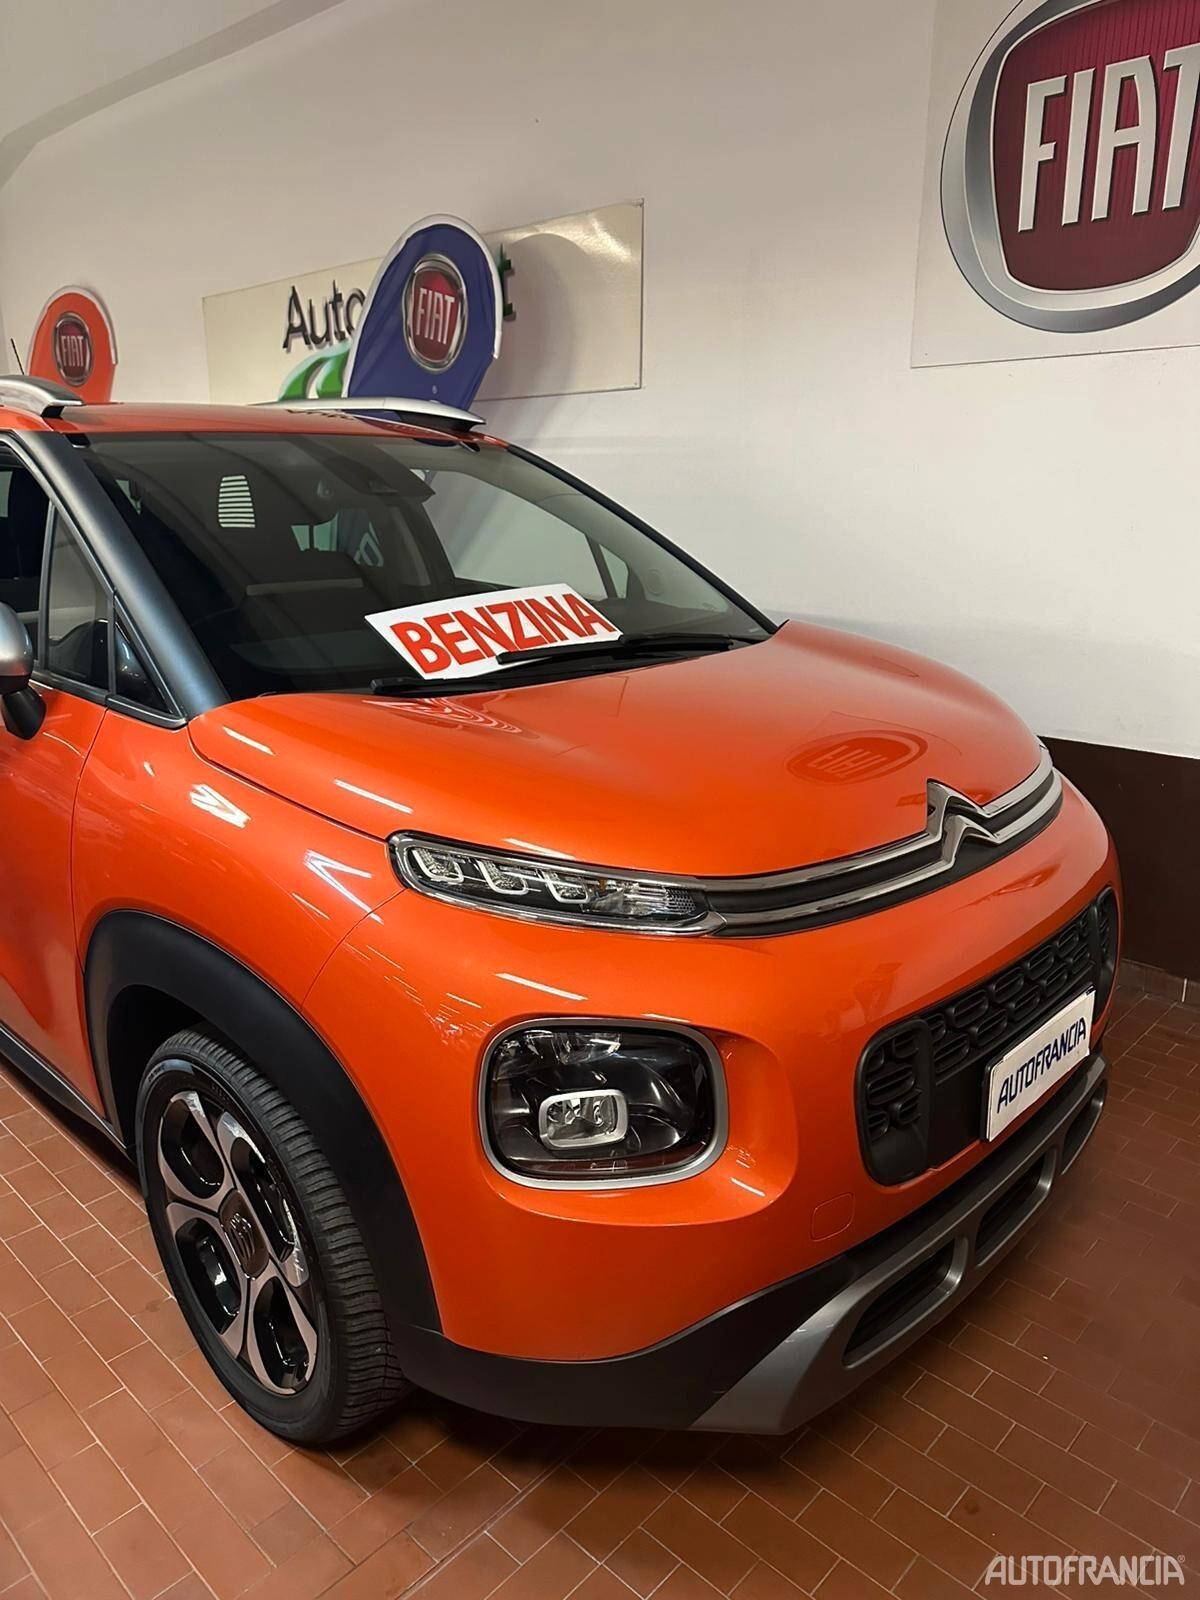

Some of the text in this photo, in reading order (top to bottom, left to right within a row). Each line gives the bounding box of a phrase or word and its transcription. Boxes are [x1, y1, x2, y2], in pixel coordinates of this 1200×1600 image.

[1018, 43, 1200, 233] FIAT
[61, 335, 84, 367] FIAT
[416, 287, 455, 345] FIAT
[390, 593, 615, 674] BENZINA
[997, 1017, 1086, 1114] AUTOFRANCIA
